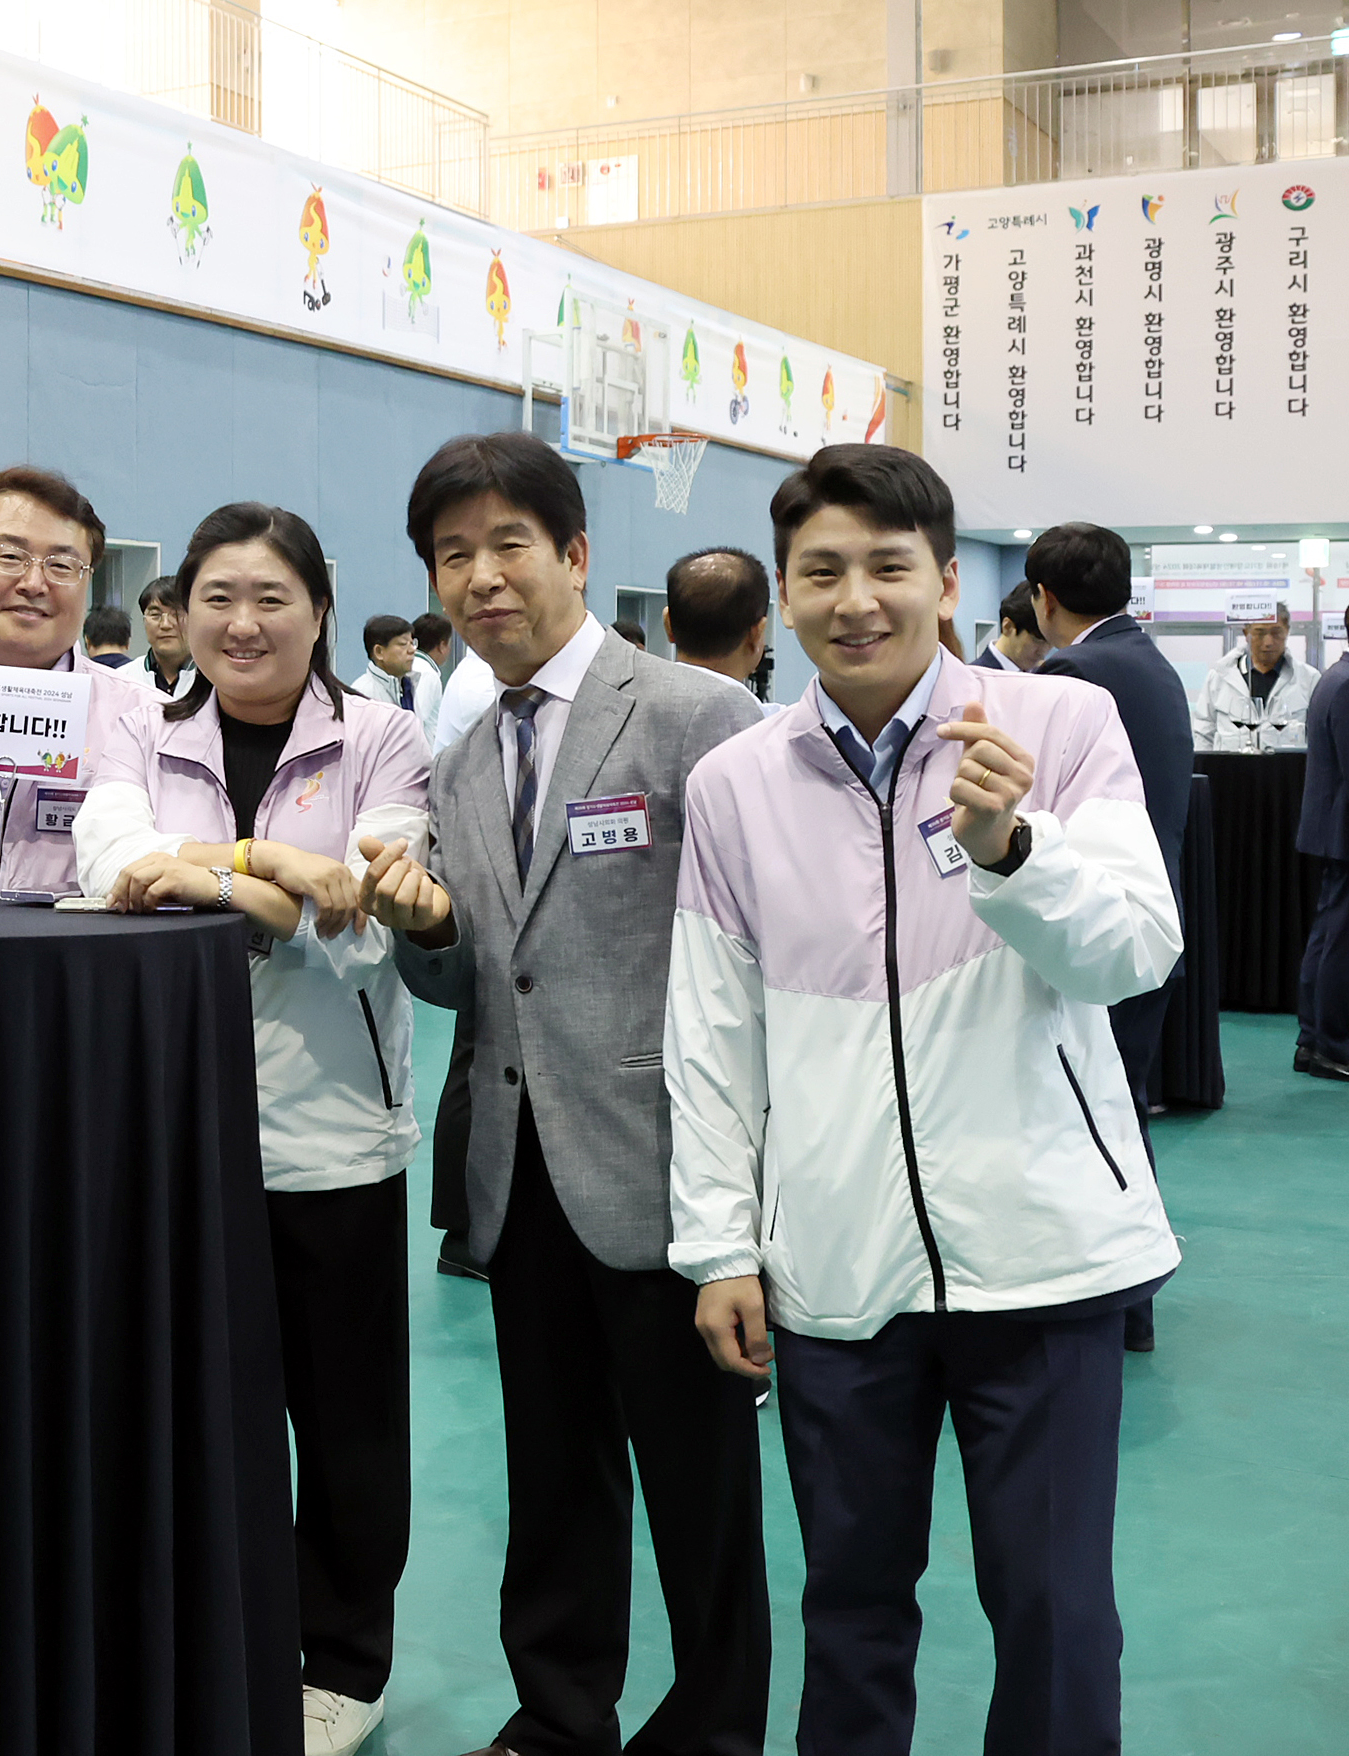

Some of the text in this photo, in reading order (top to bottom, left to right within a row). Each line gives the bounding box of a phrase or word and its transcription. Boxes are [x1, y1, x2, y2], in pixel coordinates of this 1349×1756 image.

[987, 213, 1048, 230] 고양특례시
[943, 254, 961, 431] 가평군 환영합니다
[1008, 250, 1027, 473] 고양특례시 환영합니다
[1075, 244, 1094, 425] 과천시 환영합니다
[1144, 238, 1164, 423] 광명시 환영합니다
[1215, 232, 1235, 419] 광주시 환영합니다
[1288, 227, 1309, 416] 구리시 환영합니다
[43, 689, 60, 697] 2024
[944, 844, 963, 864] 김
